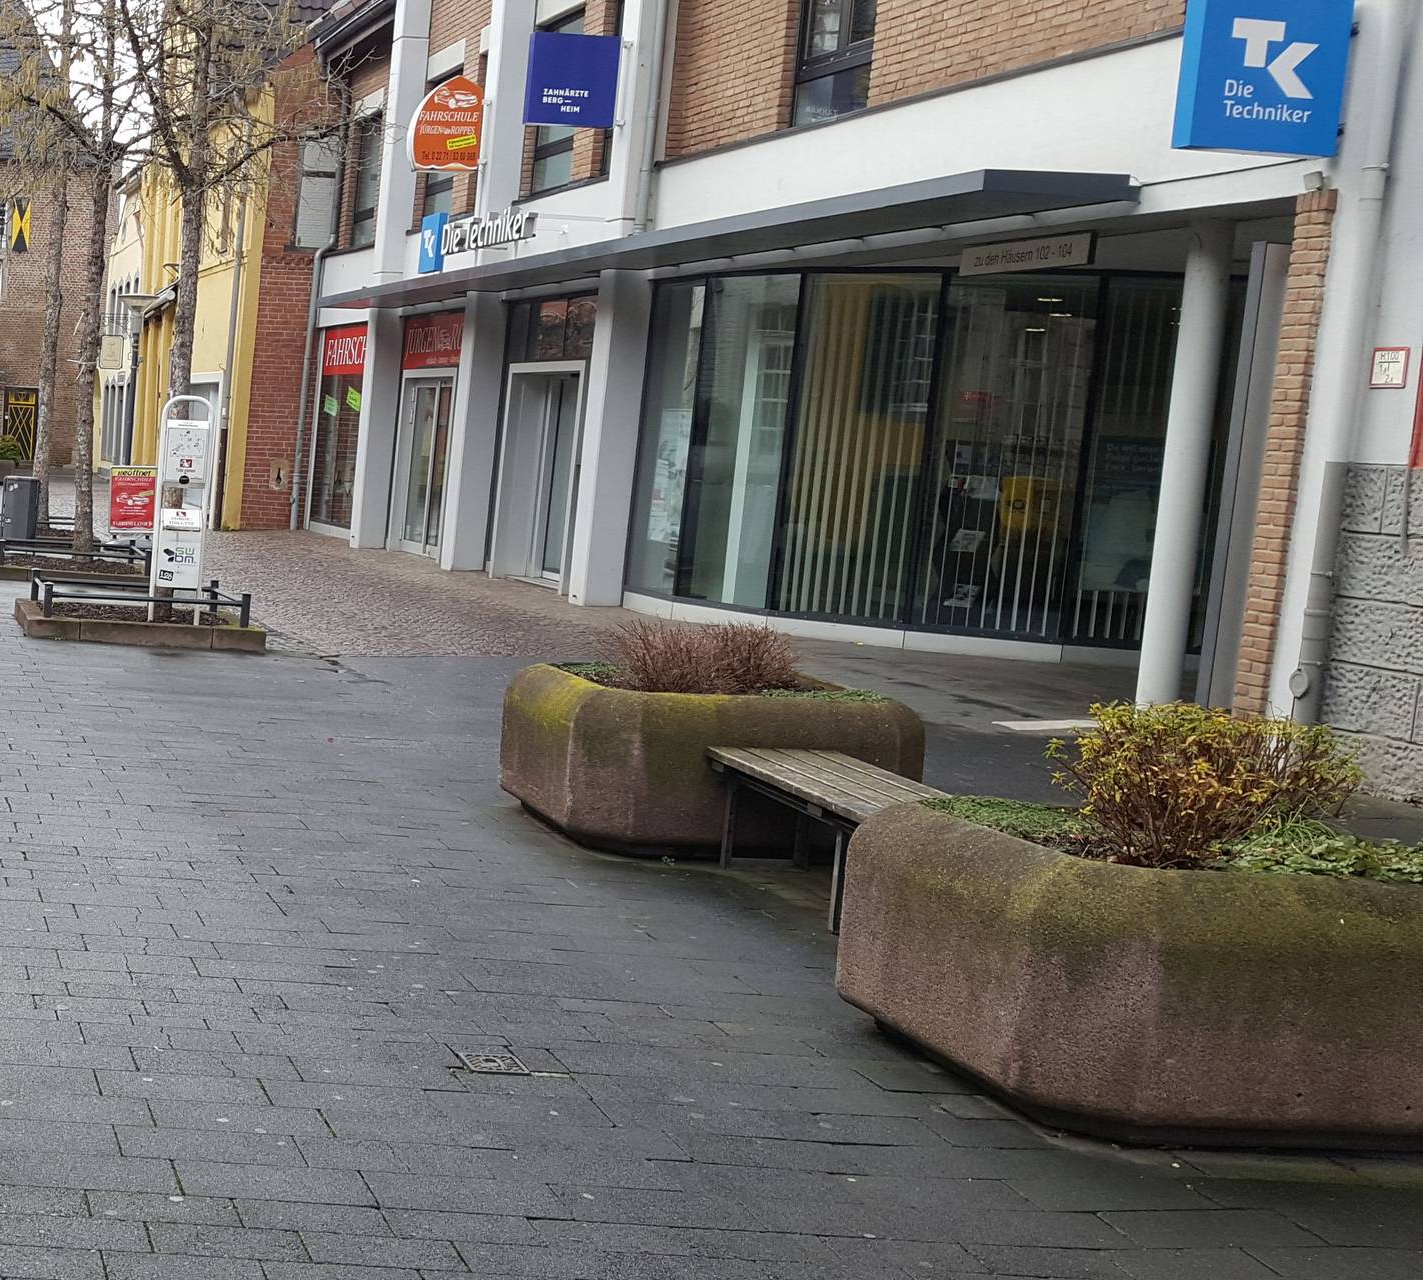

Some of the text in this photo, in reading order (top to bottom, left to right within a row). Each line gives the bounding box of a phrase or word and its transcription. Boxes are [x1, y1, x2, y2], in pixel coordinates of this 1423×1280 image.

[1232, 17, 1320, 99] TK
[543, 88, 589, 98] ZAHNÄRZTE
[1224, 79, 1254, 98] Die
[419, 110, 479, 123] FAHRSCHULE
[560, 105, 580, 113] HEIM
[1223, 100, 1313, 123] Techniker
[441, 222, 461, 255] Die
[464, 206, 530, 250] Techniker
[984, 252, 999, 266] den
[1036, 245, 1051, 260] 102
[1058, 242, 1073, 258] 104
[325, 336, 367, 366] FAHRSCH
